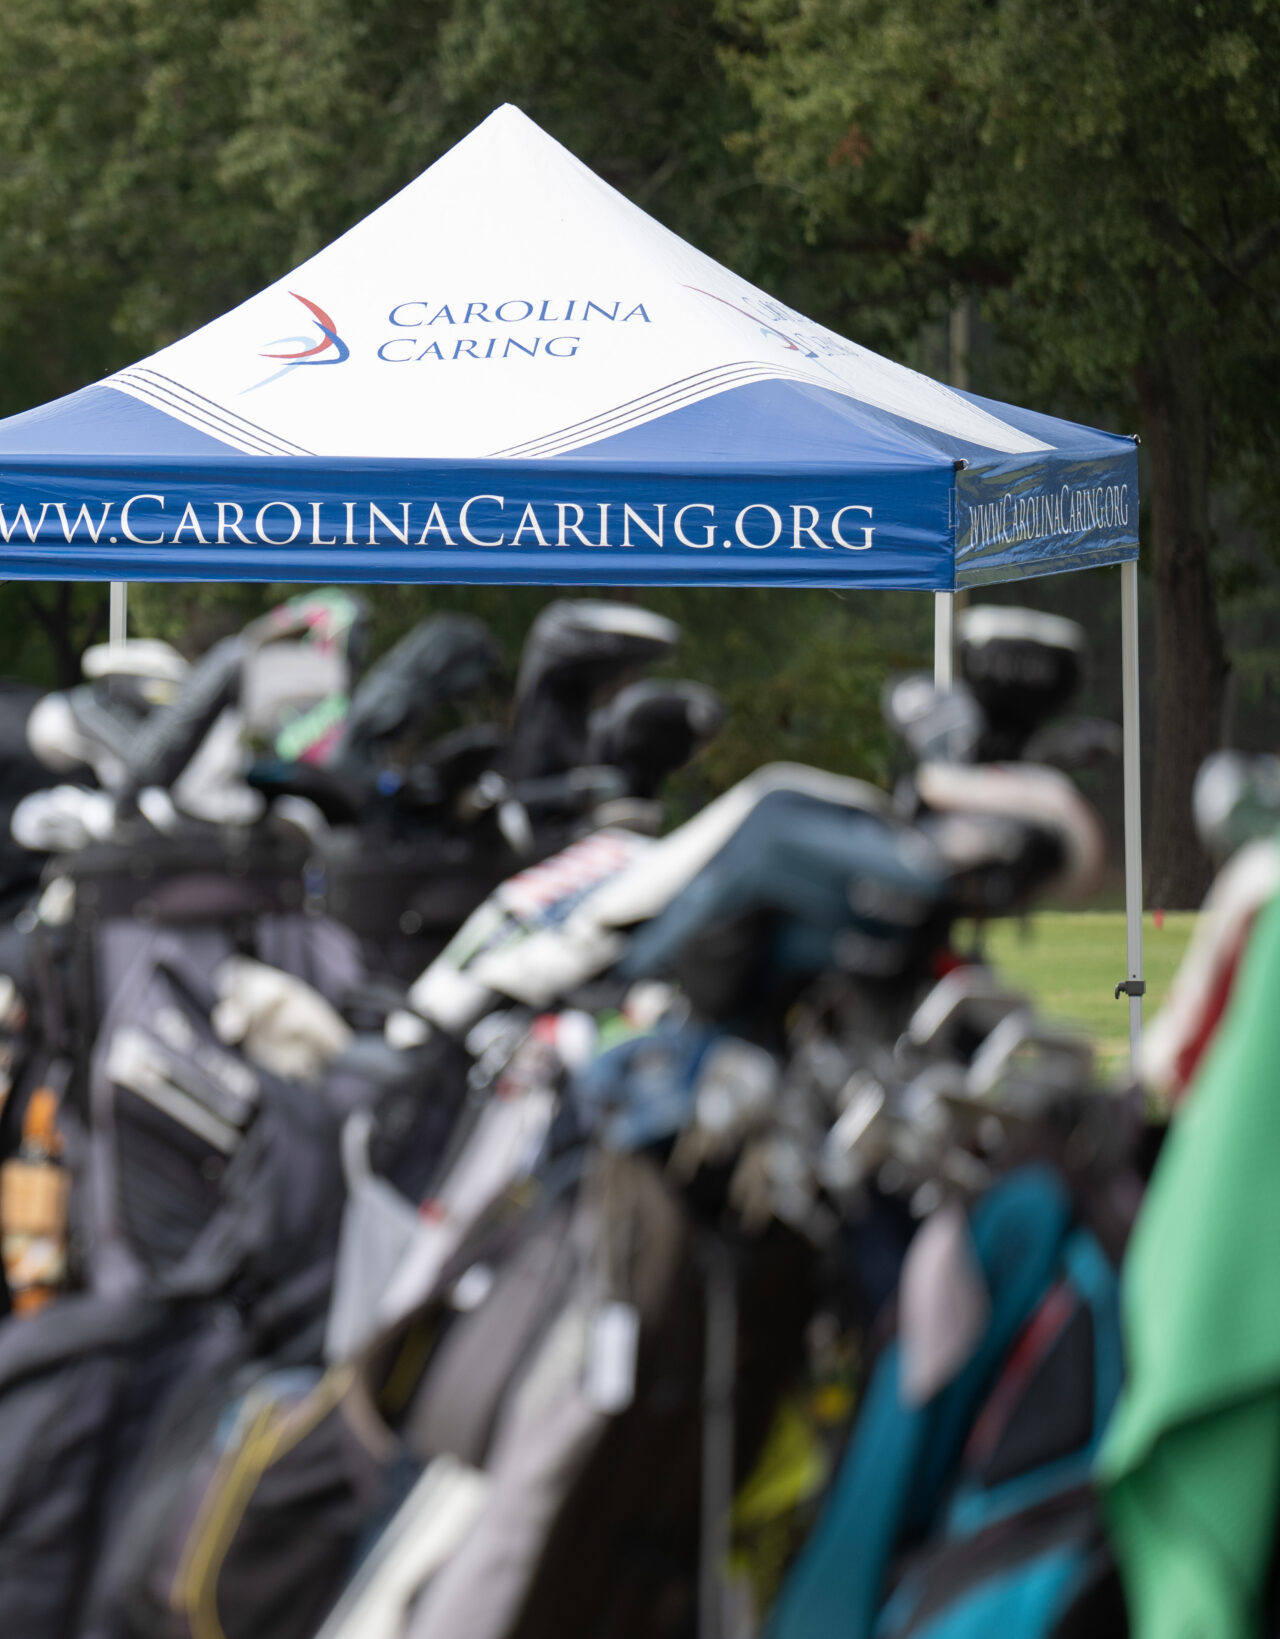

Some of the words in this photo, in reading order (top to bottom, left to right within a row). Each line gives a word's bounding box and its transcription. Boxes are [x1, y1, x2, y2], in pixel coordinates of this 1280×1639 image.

[388, 299, 653, 328] CAROLINA
[376, 336, 582, 363] CARING
[968, 484, 1129, 549] WWW.CAROLINACARING.ORG
